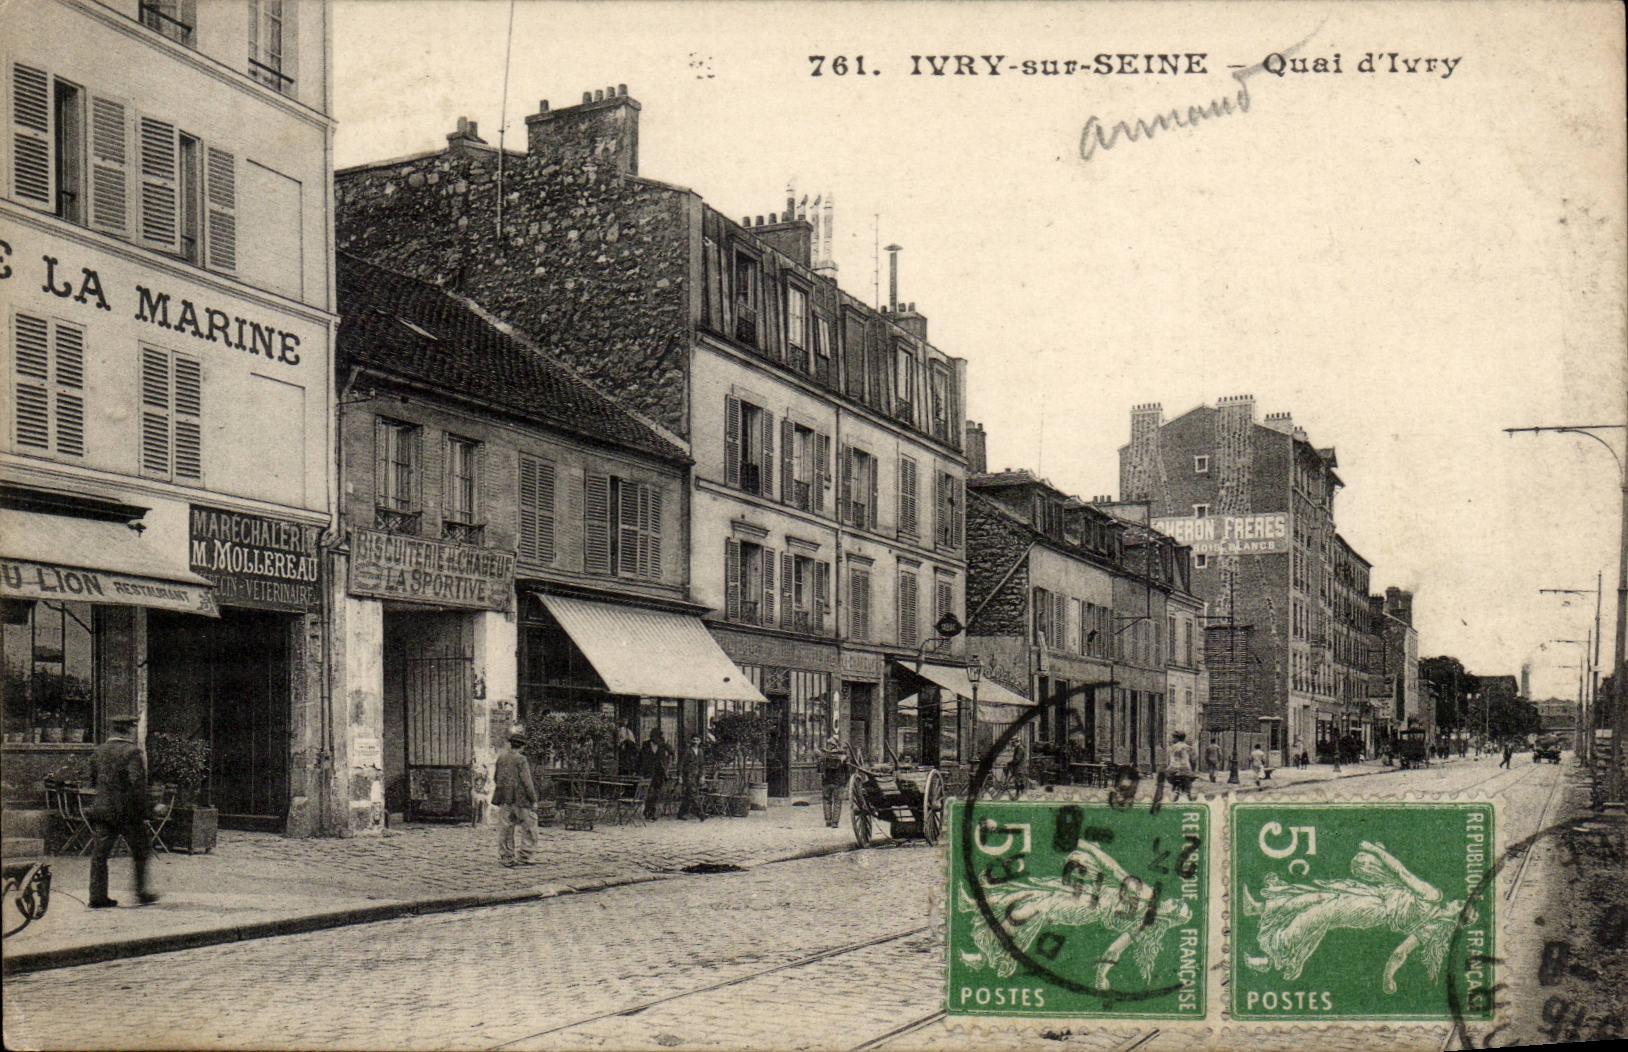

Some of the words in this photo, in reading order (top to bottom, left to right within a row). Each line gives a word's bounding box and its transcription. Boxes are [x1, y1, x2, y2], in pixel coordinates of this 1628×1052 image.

[42, 255, 111, 311] LA
[135, 285, 301, 366] MARINE
[212, 539, 319, 582] MOLLEREAU
[36, 567, 105, 597] LION
[113, 581, 190, 603] RESTAURANT
[410, 568, 486, 600] SPORTIVE
[960, 987, 1046, 1008] POSTES
[1246, 991, 1334, 1011] POSTES
